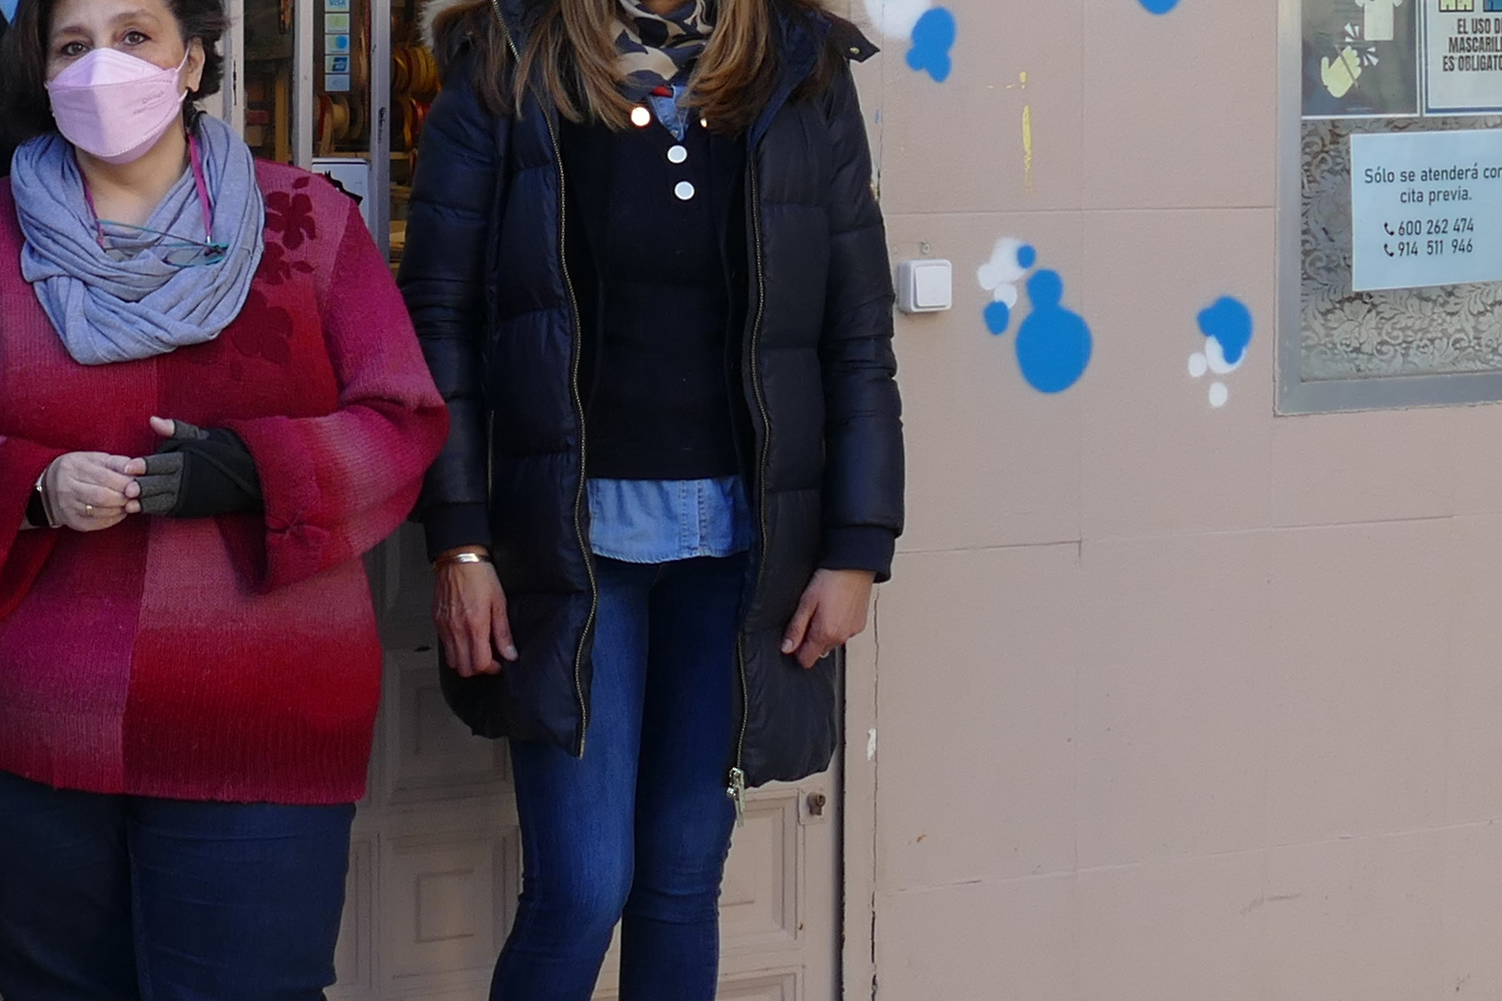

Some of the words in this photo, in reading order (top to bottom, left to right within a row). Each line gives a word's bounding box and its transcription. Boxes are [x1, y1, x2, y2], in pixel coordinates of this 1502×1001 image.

[1457, 18, 1469, 34] EL
[1471, 18, 1491, 34] USO
[1494, 18, 1502, 34] D
[1448, 36, 1502, 53] MASCARIL
[1443, 55, 1455, 72] ES
[1364, 166, 1395, 184] Sólo
[1400, 170, 1416, 182] se
[1420, 162, 1479, 182] atenderá
[1400, 187, 1424, 204] cita
[1428, 186, 1472, 206] previa.
[1398, 219, 1422, 236] 600
[1426, 218, 1449, 235] 262
[1453, 217, 1475, 233] 474
[1398, 241, 1418, 257] 914
[1426, 239, 1444, 255] 511
[1451, 238, 1474, 254] 946
